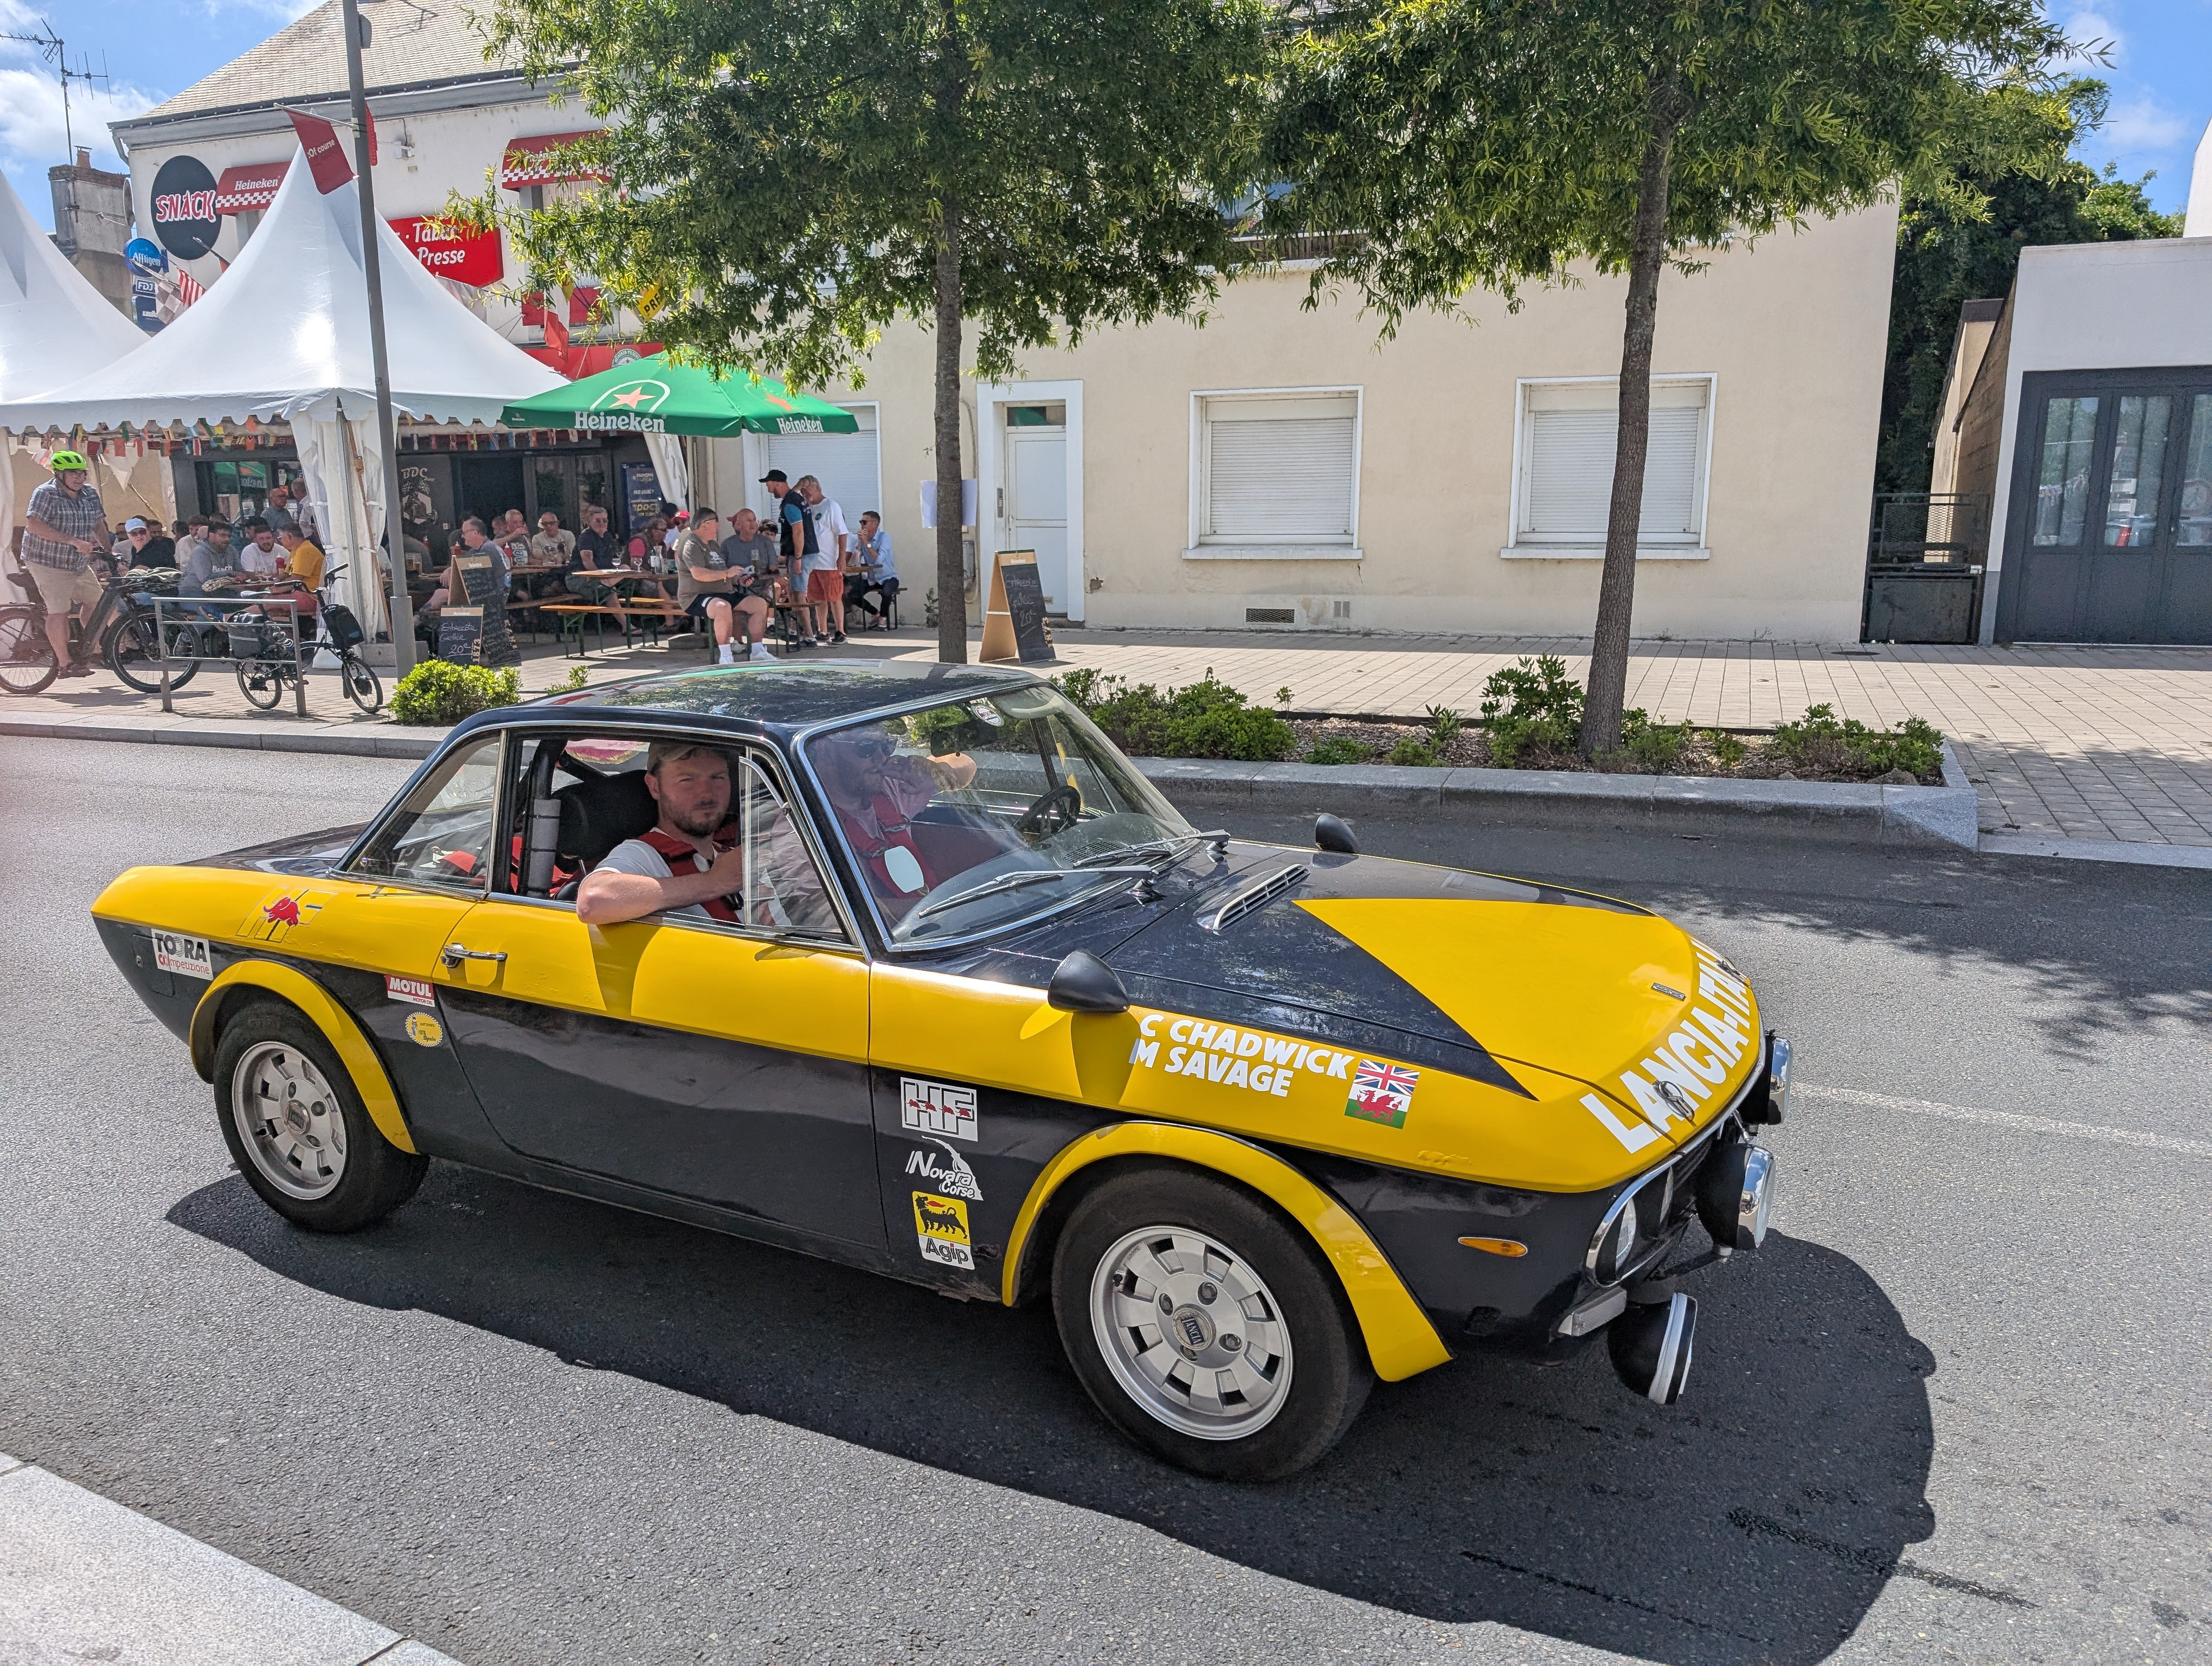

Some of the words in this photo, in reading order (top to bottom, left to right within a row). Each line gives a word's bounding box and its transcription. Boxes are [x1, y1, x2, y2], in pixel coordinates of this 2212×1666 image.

[317, 139, 335, 153] course
[234, 178, 279, 191] Heineken
[156, 190, 217, 223] SNACK
[132, 252, 160, 267] Affligem
[417, 247, 466, 266] Presse
[138, 281, 153, 291] FDJ
[574, 411, 665, 433] Heineken
[776, 416, 824, 434] Heineken
[401, 467, 428, 479] BDC
[390, 977, 432, 997] MOTUL
[1140, 1014, 1164, 1037] C
[1169, 1019, 1355, 1080] CHADWICK
[1128, 1038, 1160, 1068] M
[1164, 1047, 1295, 1098] SAVAGE
[903, 1080, 975, 1136] HF
[940, 1180, 975, 1199] Corse
[925, 1237, 969, 1265] Agip
[1181, 1317, 1202, 1344] LANCIA
